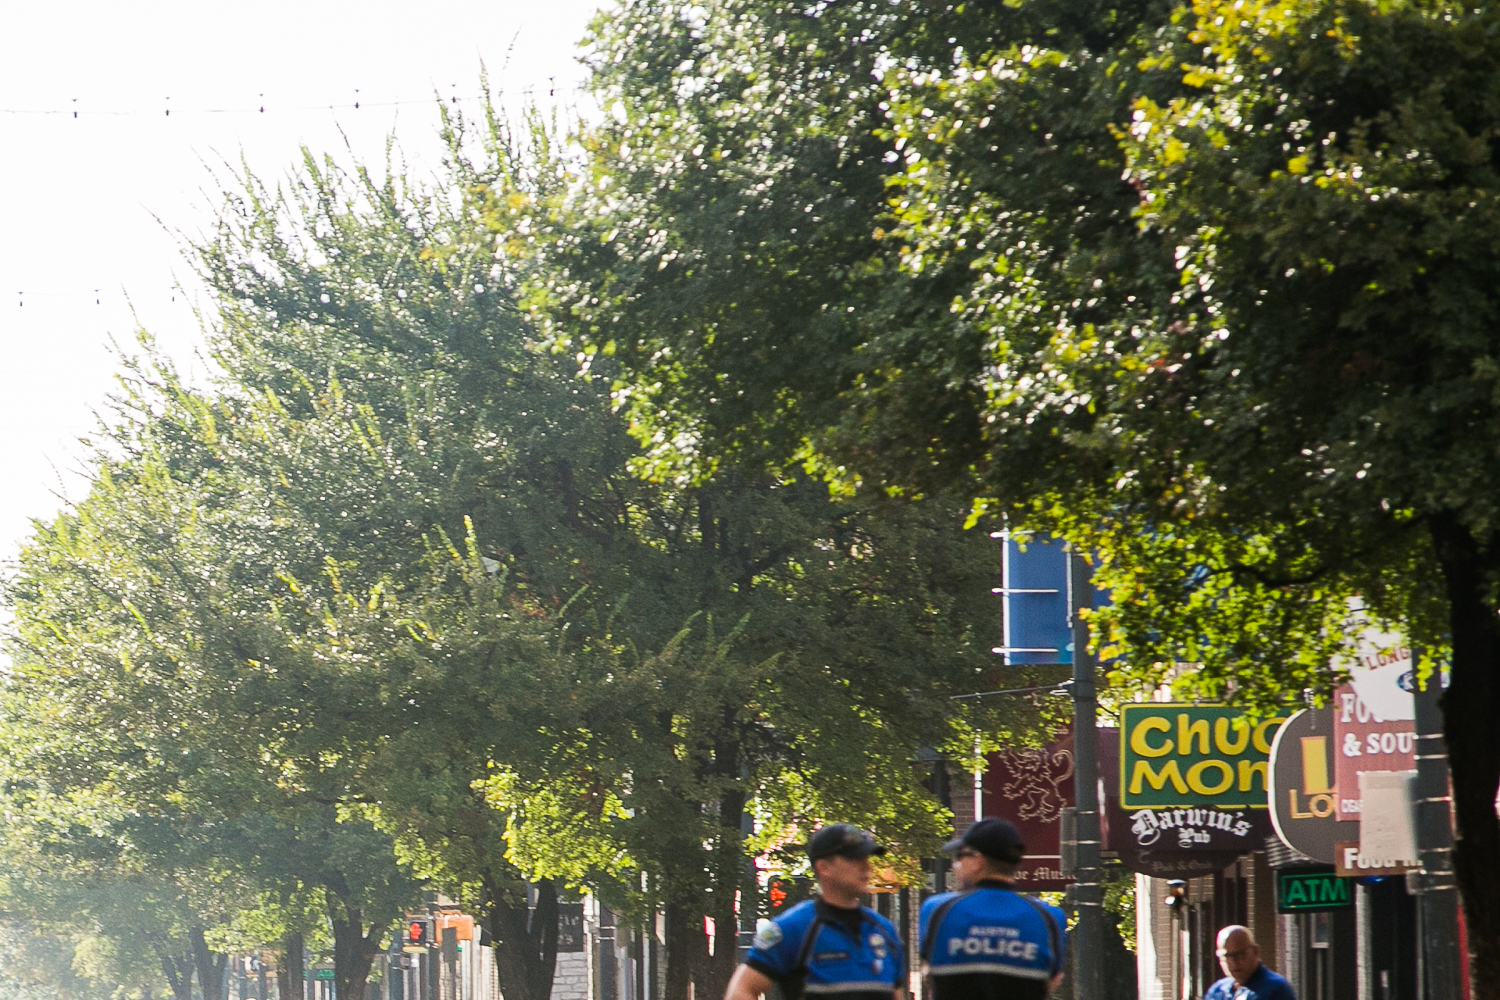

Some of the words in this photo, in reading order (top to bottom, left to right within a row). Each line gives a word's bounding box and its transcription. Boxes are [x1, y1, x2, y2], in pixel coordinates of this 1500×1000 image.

[1343, 733, 1362, 757] &
[1129, 808, 1252, 846] Darwin's
[1177, 827, 1211, 848] Pub
[1287, 878, 1346, 903] ATM
[948, 937, 1040, 961] POLICE
